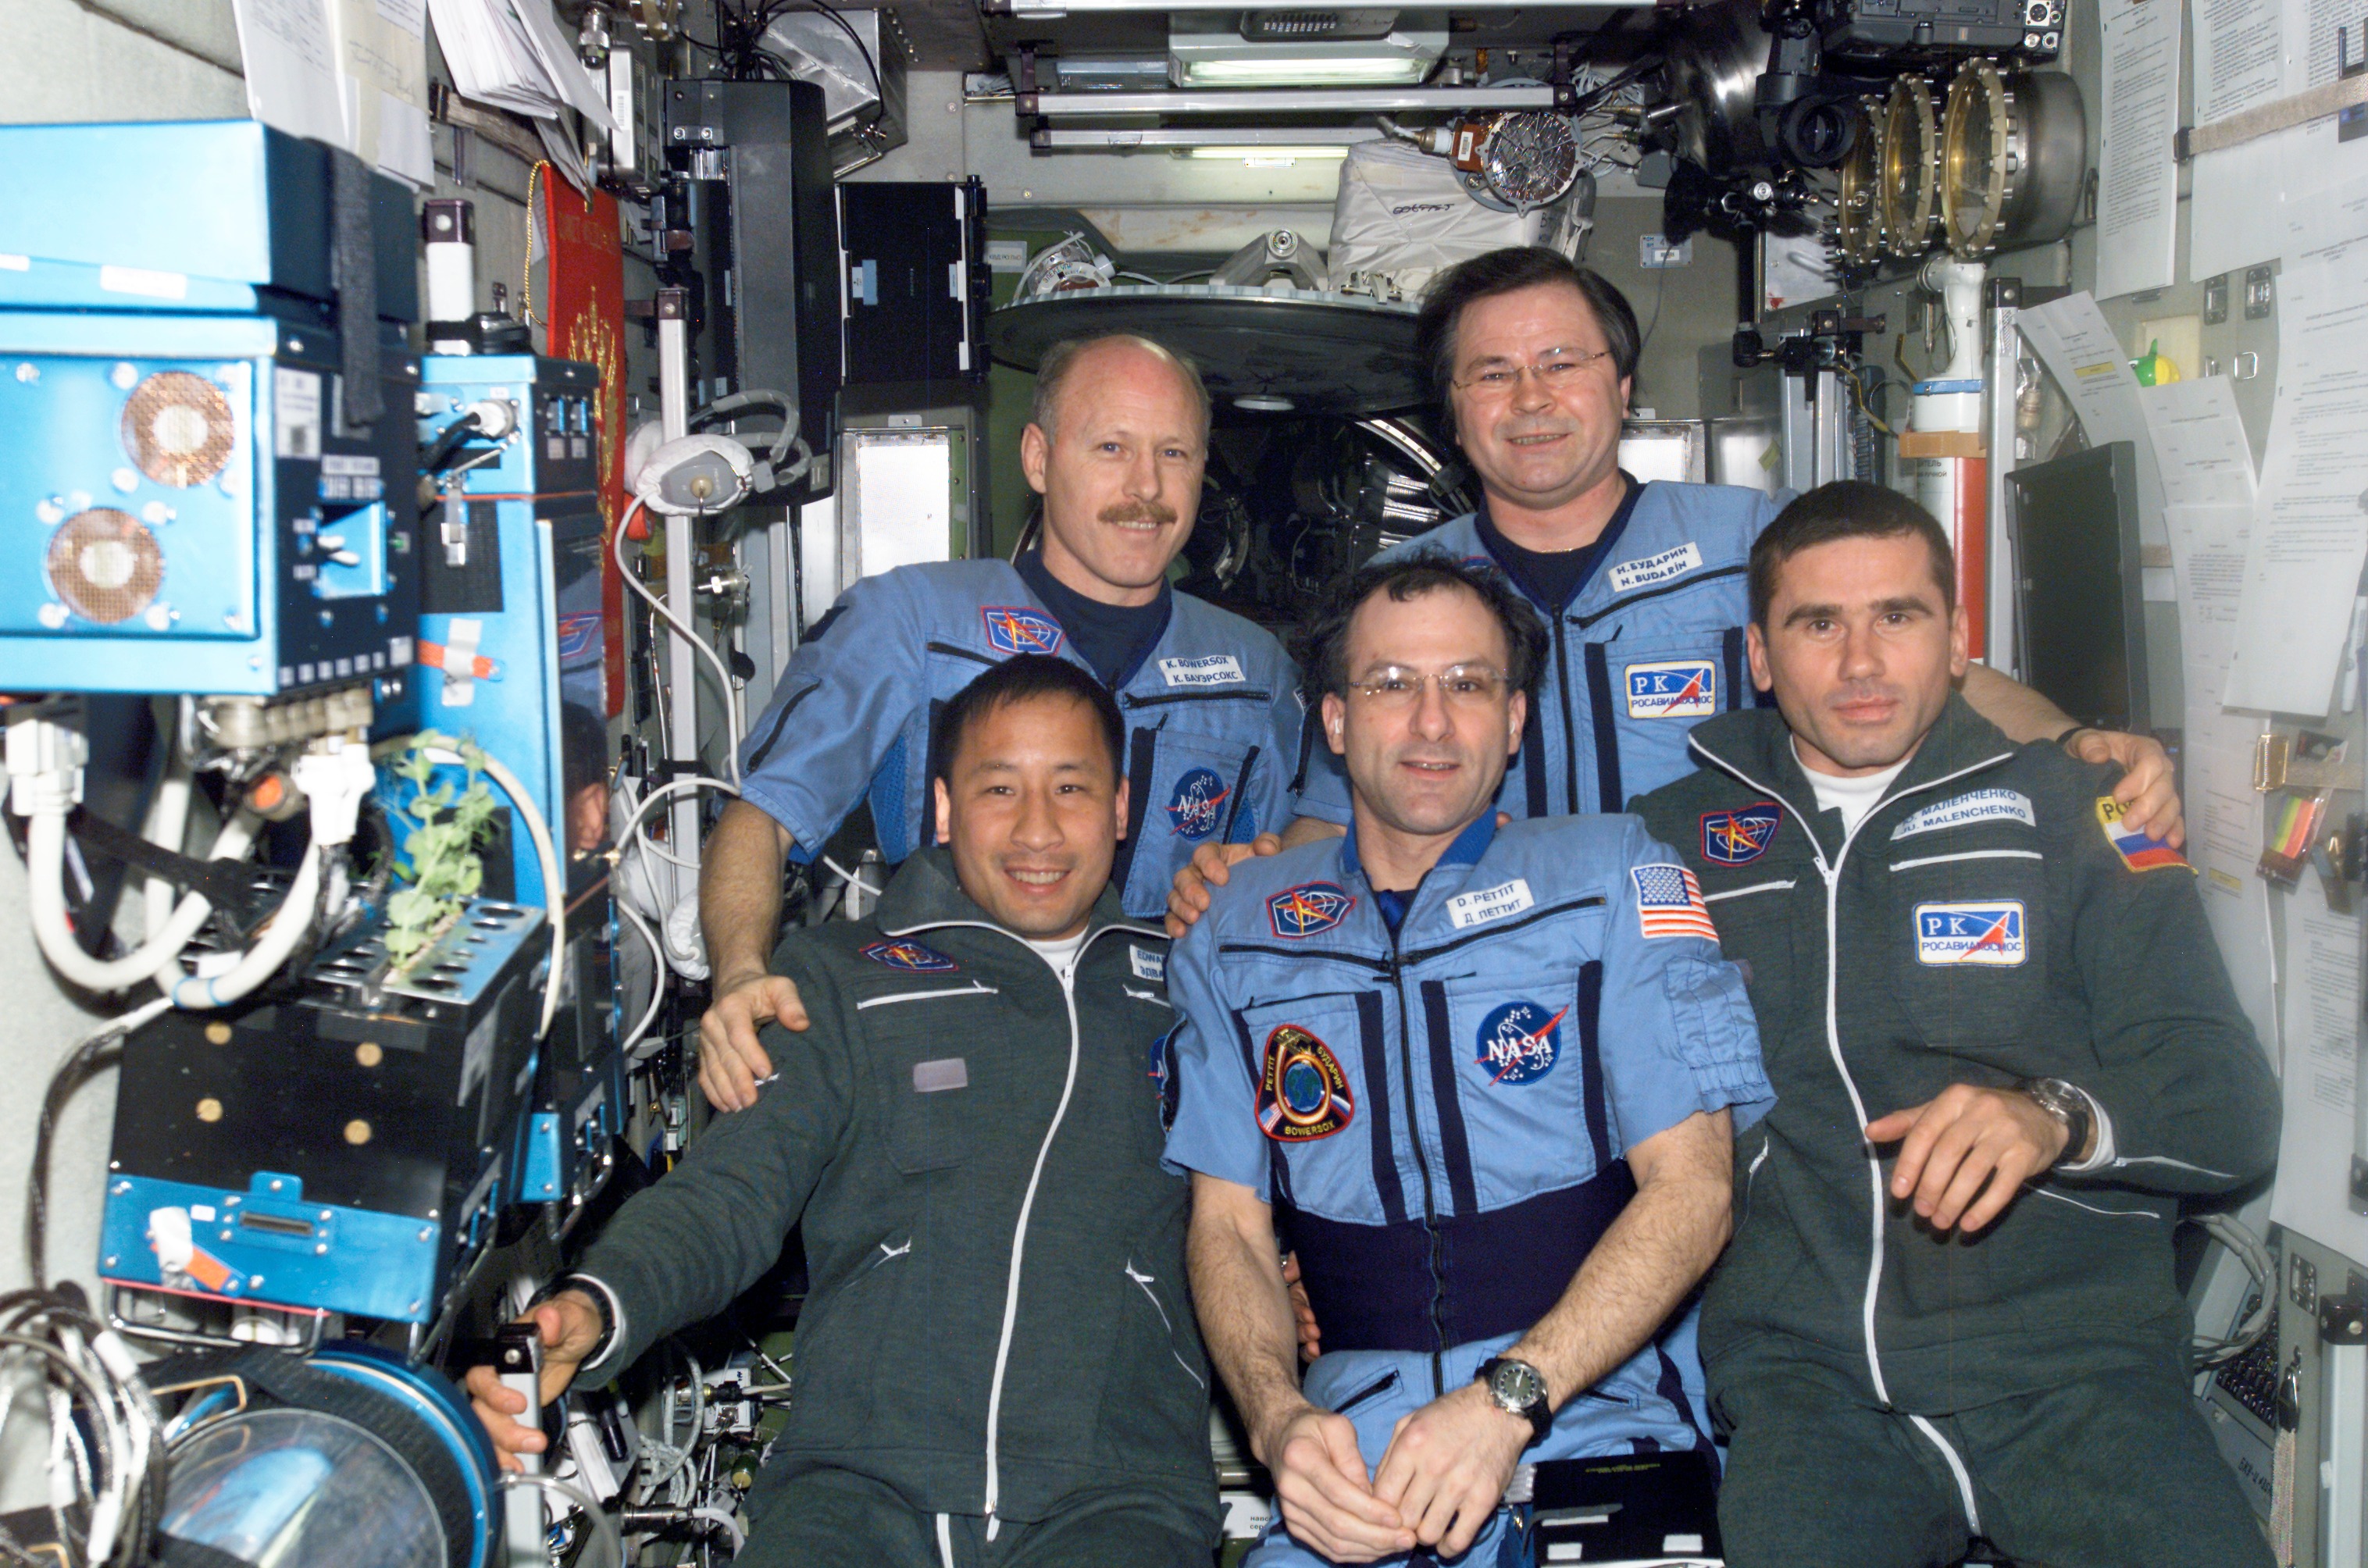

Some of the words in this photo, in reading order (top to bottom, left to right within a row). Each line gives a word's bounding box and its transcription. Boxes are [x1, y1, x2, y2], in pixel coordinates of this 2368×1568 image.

[1166, 660, 1177, 668] K.
[1178, 656, 1229, 668] BOWERSOX
[1173, 674, 1183, 683] К.
[1184, 671, 1239, 682] БАУЭРСОКС
[1177, 794, 1217, 821] NASA
[1921, 789, 2017, 817] МАЛЕНЧЕНКО
[1923, 804, 2027, 827] MALENCHENKO
[1474, 883, 1514, 904] PETTIT
[1478, 898, 1521, 920] ПЕТТИТ
[1137, 949, 1164, 963] EDWA
[1486, 1035, 1553, 1061] NASA
[1265, 1054, 1275, 1092] PETTIT
[1316, 1046, 1344, 1089] БУДАРИН
[1284, 1119, 1336, 1137] BOWERSOX
